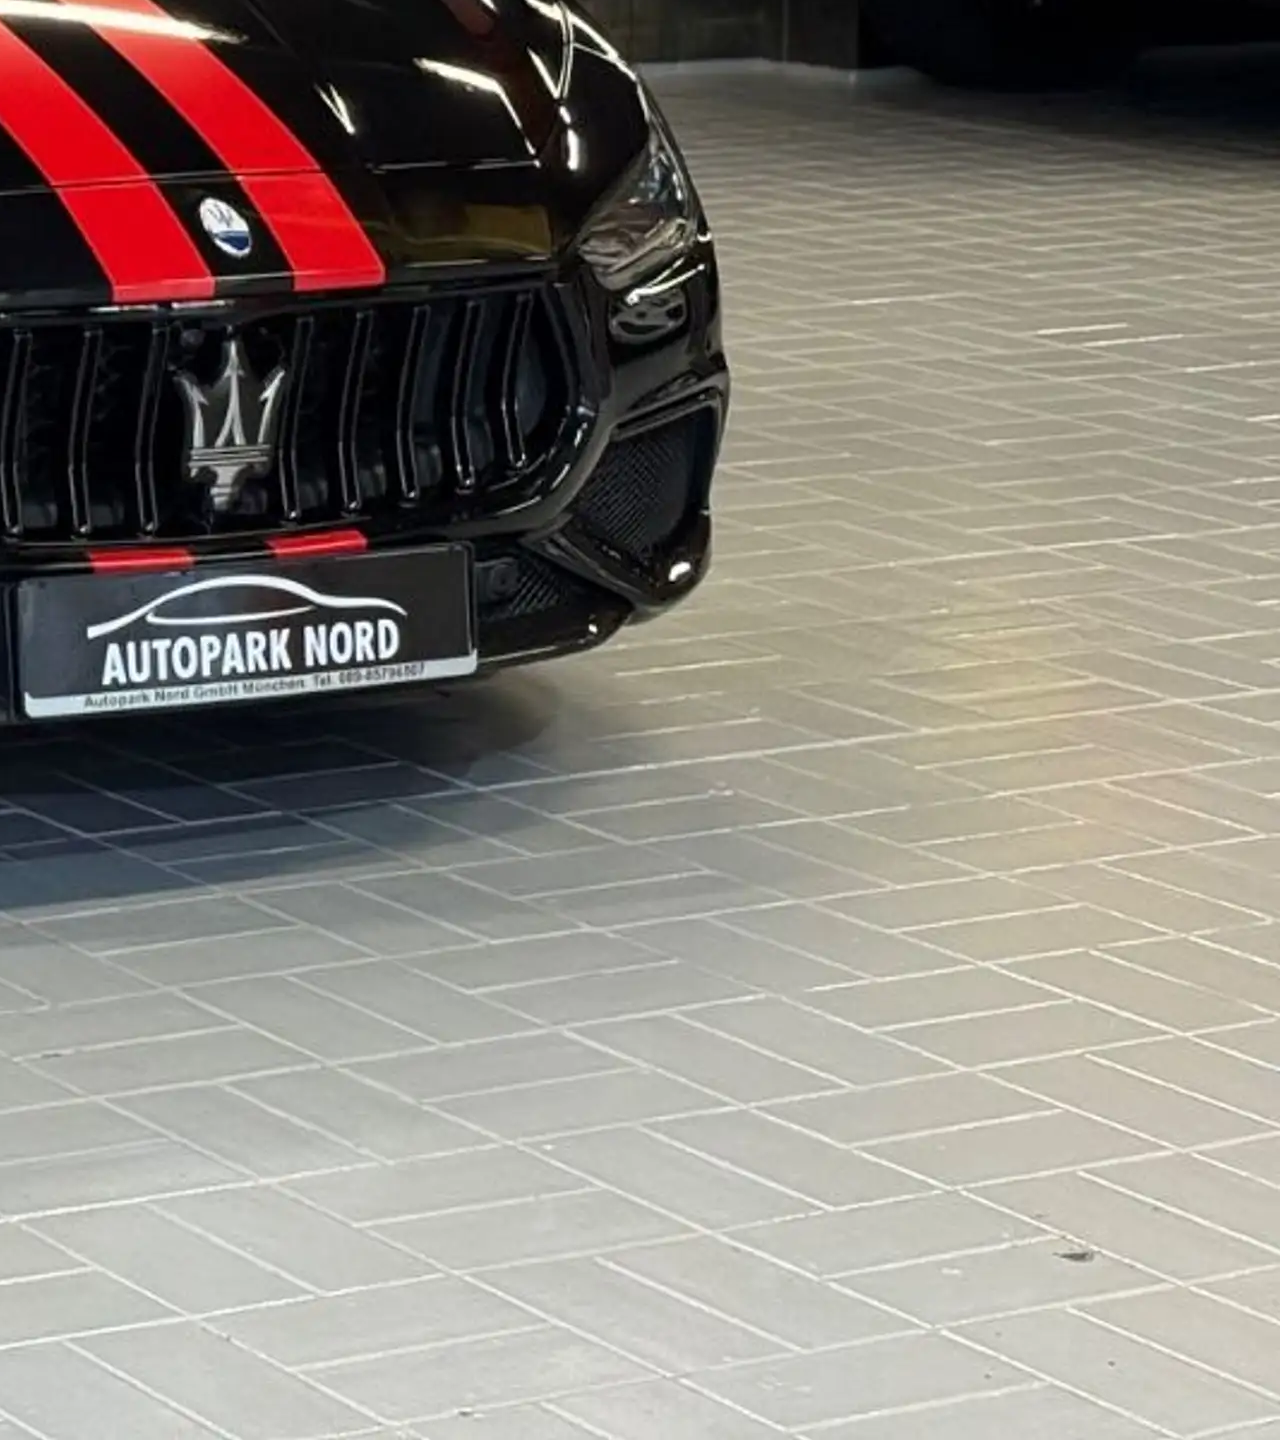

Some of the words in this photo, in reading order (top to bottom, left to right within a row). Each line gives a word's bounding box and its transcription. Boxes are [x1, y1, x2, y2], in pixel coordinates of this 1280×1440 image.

[102, 627, 292, 686] AUTOPARK
[304, 619, 399, 666] NORD
[84, 690, 151, 709] Autopark
[154, 686, 190, 701] Nord
